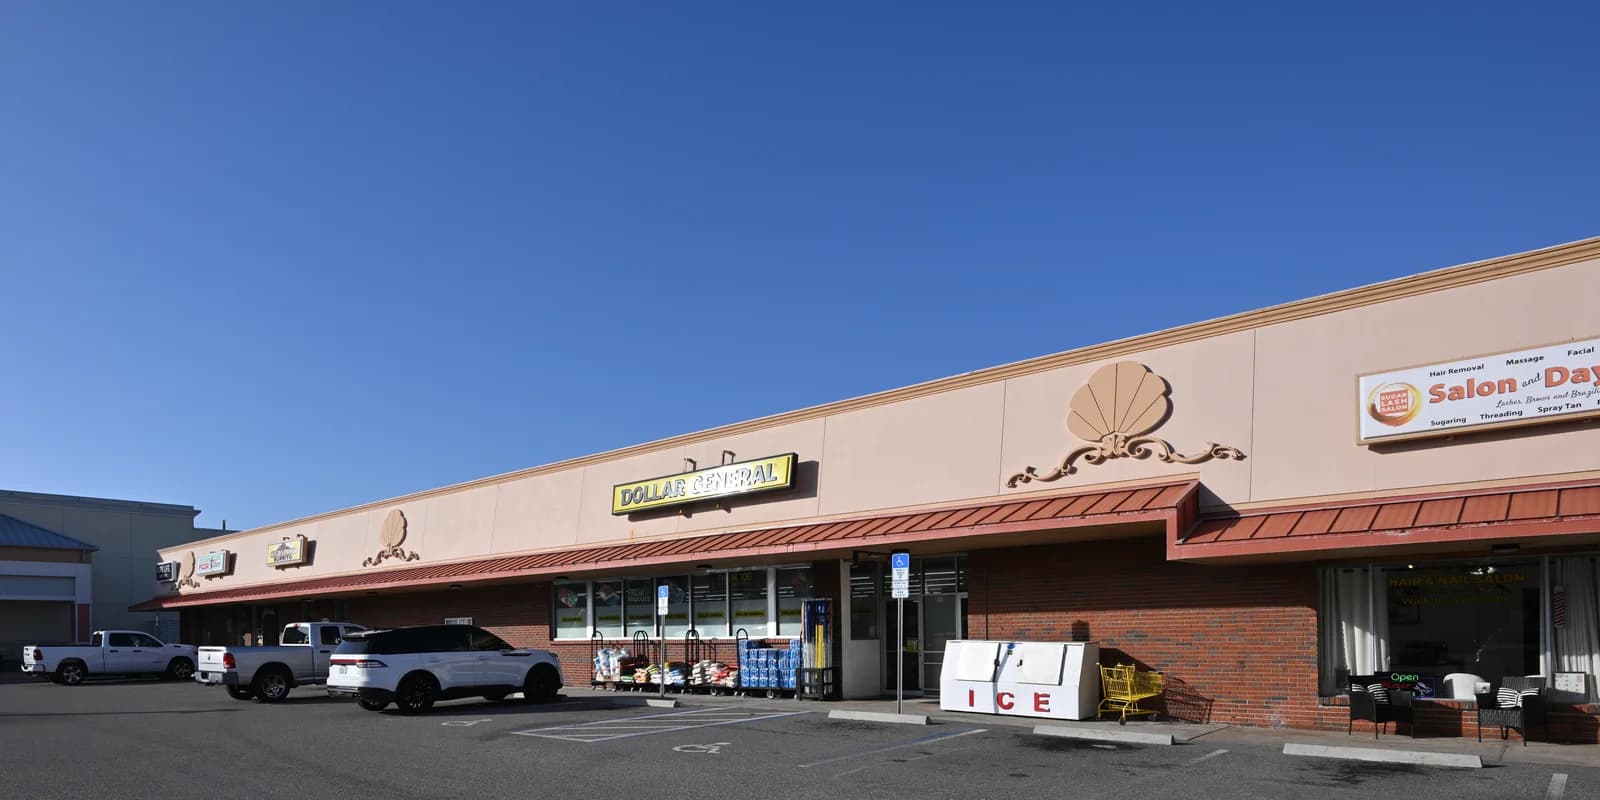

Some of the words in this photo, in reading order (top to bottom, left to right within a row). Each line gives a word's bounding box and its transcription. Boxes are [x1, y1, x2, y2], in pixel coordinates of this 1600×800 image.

[1567, 346, 1595, 357] Facial
[1506, 354, 1544, 366] Massage
[1429, 369, 1447, 377] Hair
[1448, 363, 1485, 375] Removal
[1428, 377, 1517, 403] Salon
[1521, 372, 1542, 388] and
[1381, 392, 1407, 401] SUGAR
[1553, 391, 1569, 400] and
[1381, 398, 1407, 407] LASH
[1381, 404, 1407, 412] SALON
[1480, 408, 1523, 420] Threading
[1537, 404, 1563, 413] Spray
[1430, 416, 1467, 427] Sugaring
[620, 478, 686, 506] DOLLAR
[691, 462, 778, 495] GENERAL
[1389, 576, 1420, 587] HAIR
[1474, 573, 1526, 584] SALON
[1391, 673, 1419, 682] Open
